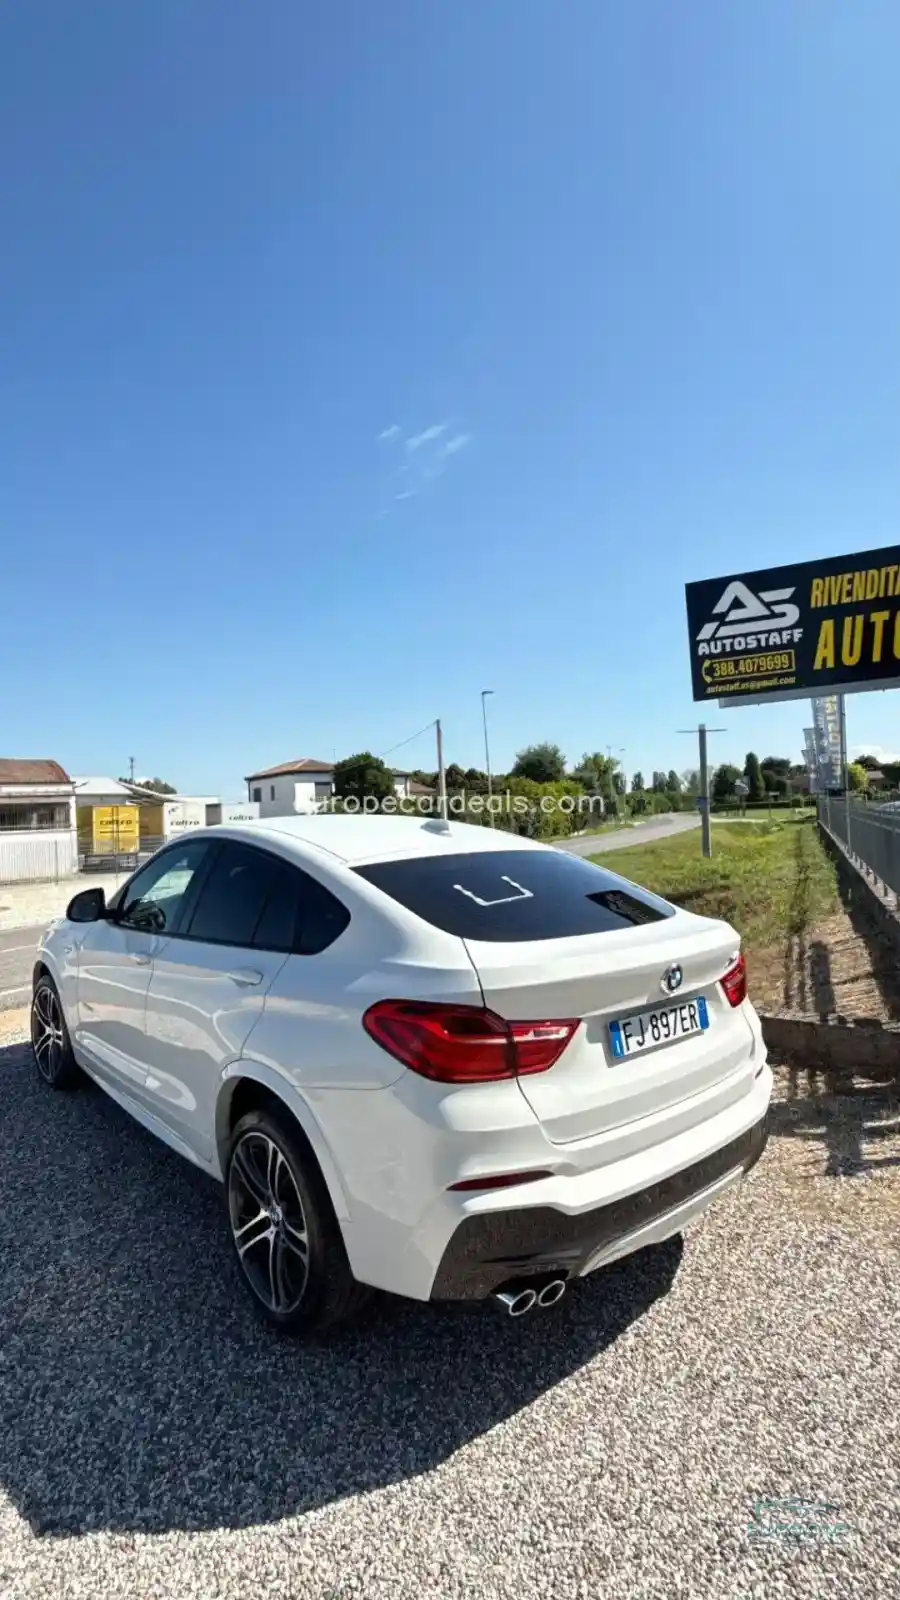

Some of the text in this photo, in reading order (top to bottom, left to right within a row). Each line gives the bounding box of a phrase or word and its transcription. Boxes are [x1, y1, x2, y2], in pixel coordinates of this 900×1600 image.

[698, 628, 803, 656] AUTOSTAFF
[712, 654, 790, 677] 388.4079699
[649, 1003, 699, 1041] 897ER
